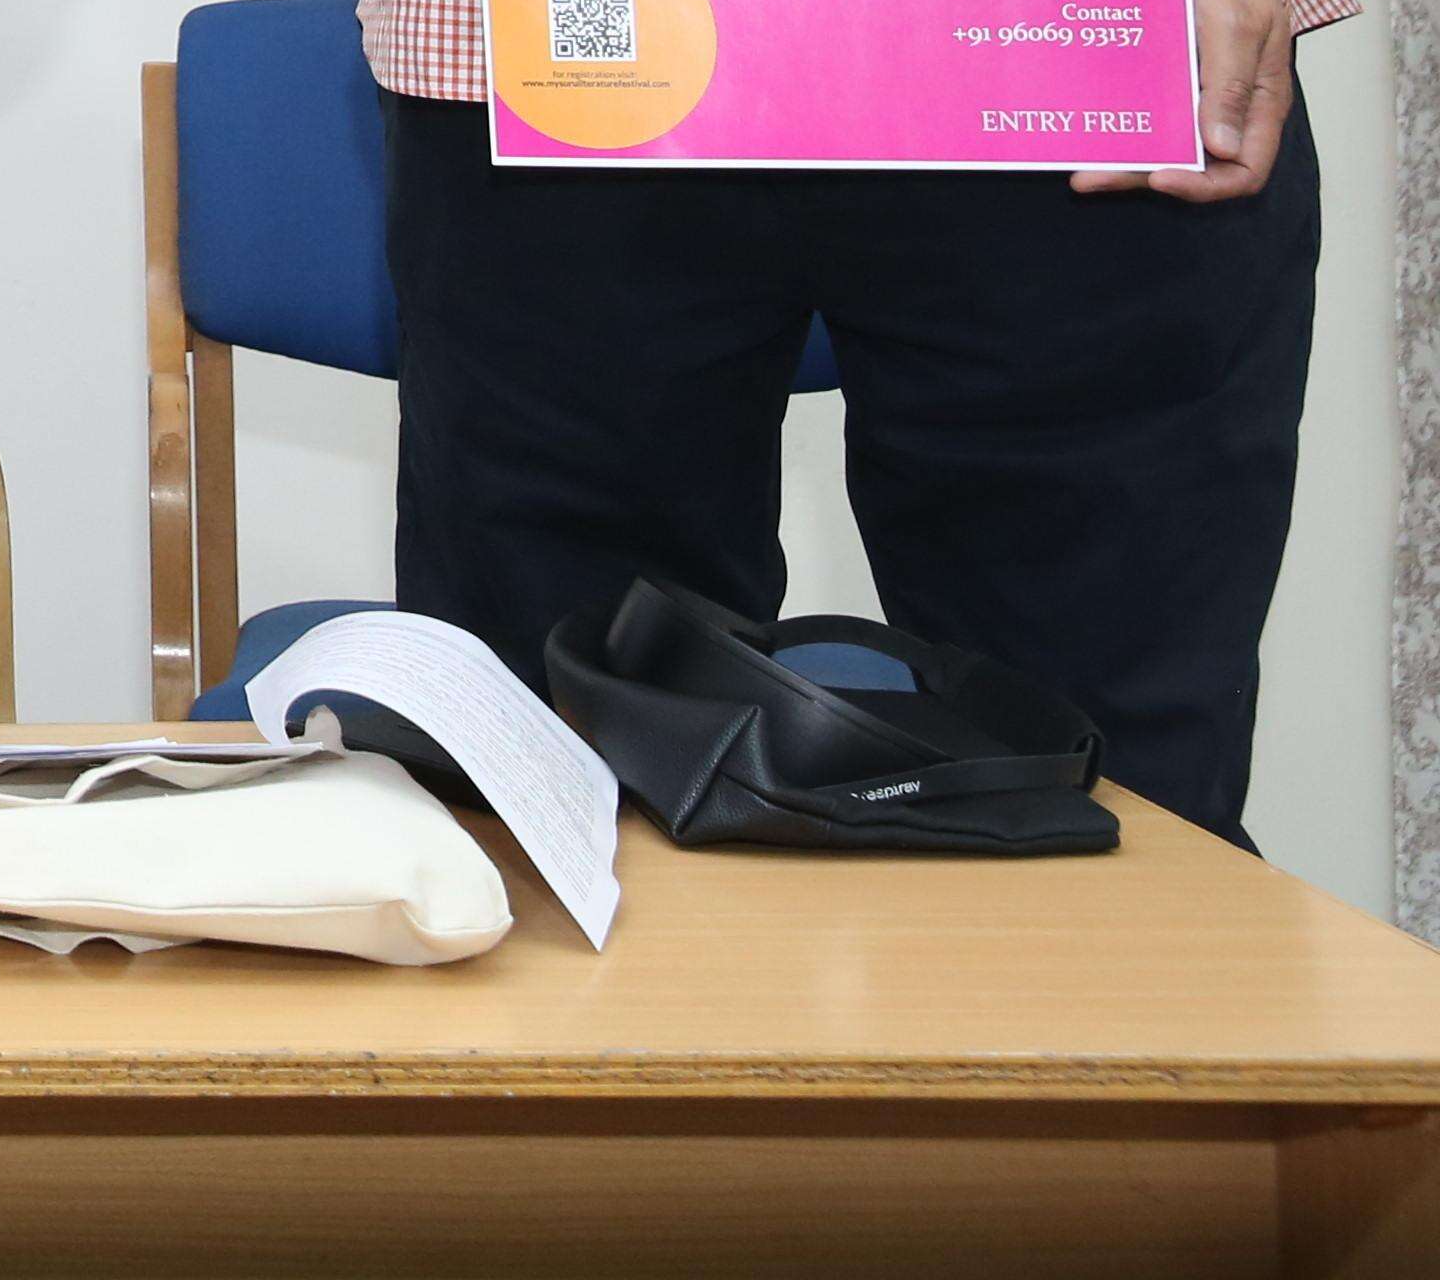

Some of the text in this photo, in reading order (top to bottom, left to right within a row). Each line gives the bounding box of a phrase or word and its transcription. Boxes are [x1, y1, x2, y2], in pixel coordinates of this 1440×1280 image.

[1062, 3, 1141, 21] Contact
[953, 22, 1143, 47] +91 96069 93137
[981, 111, 1152, 133] ENTRY FREE
